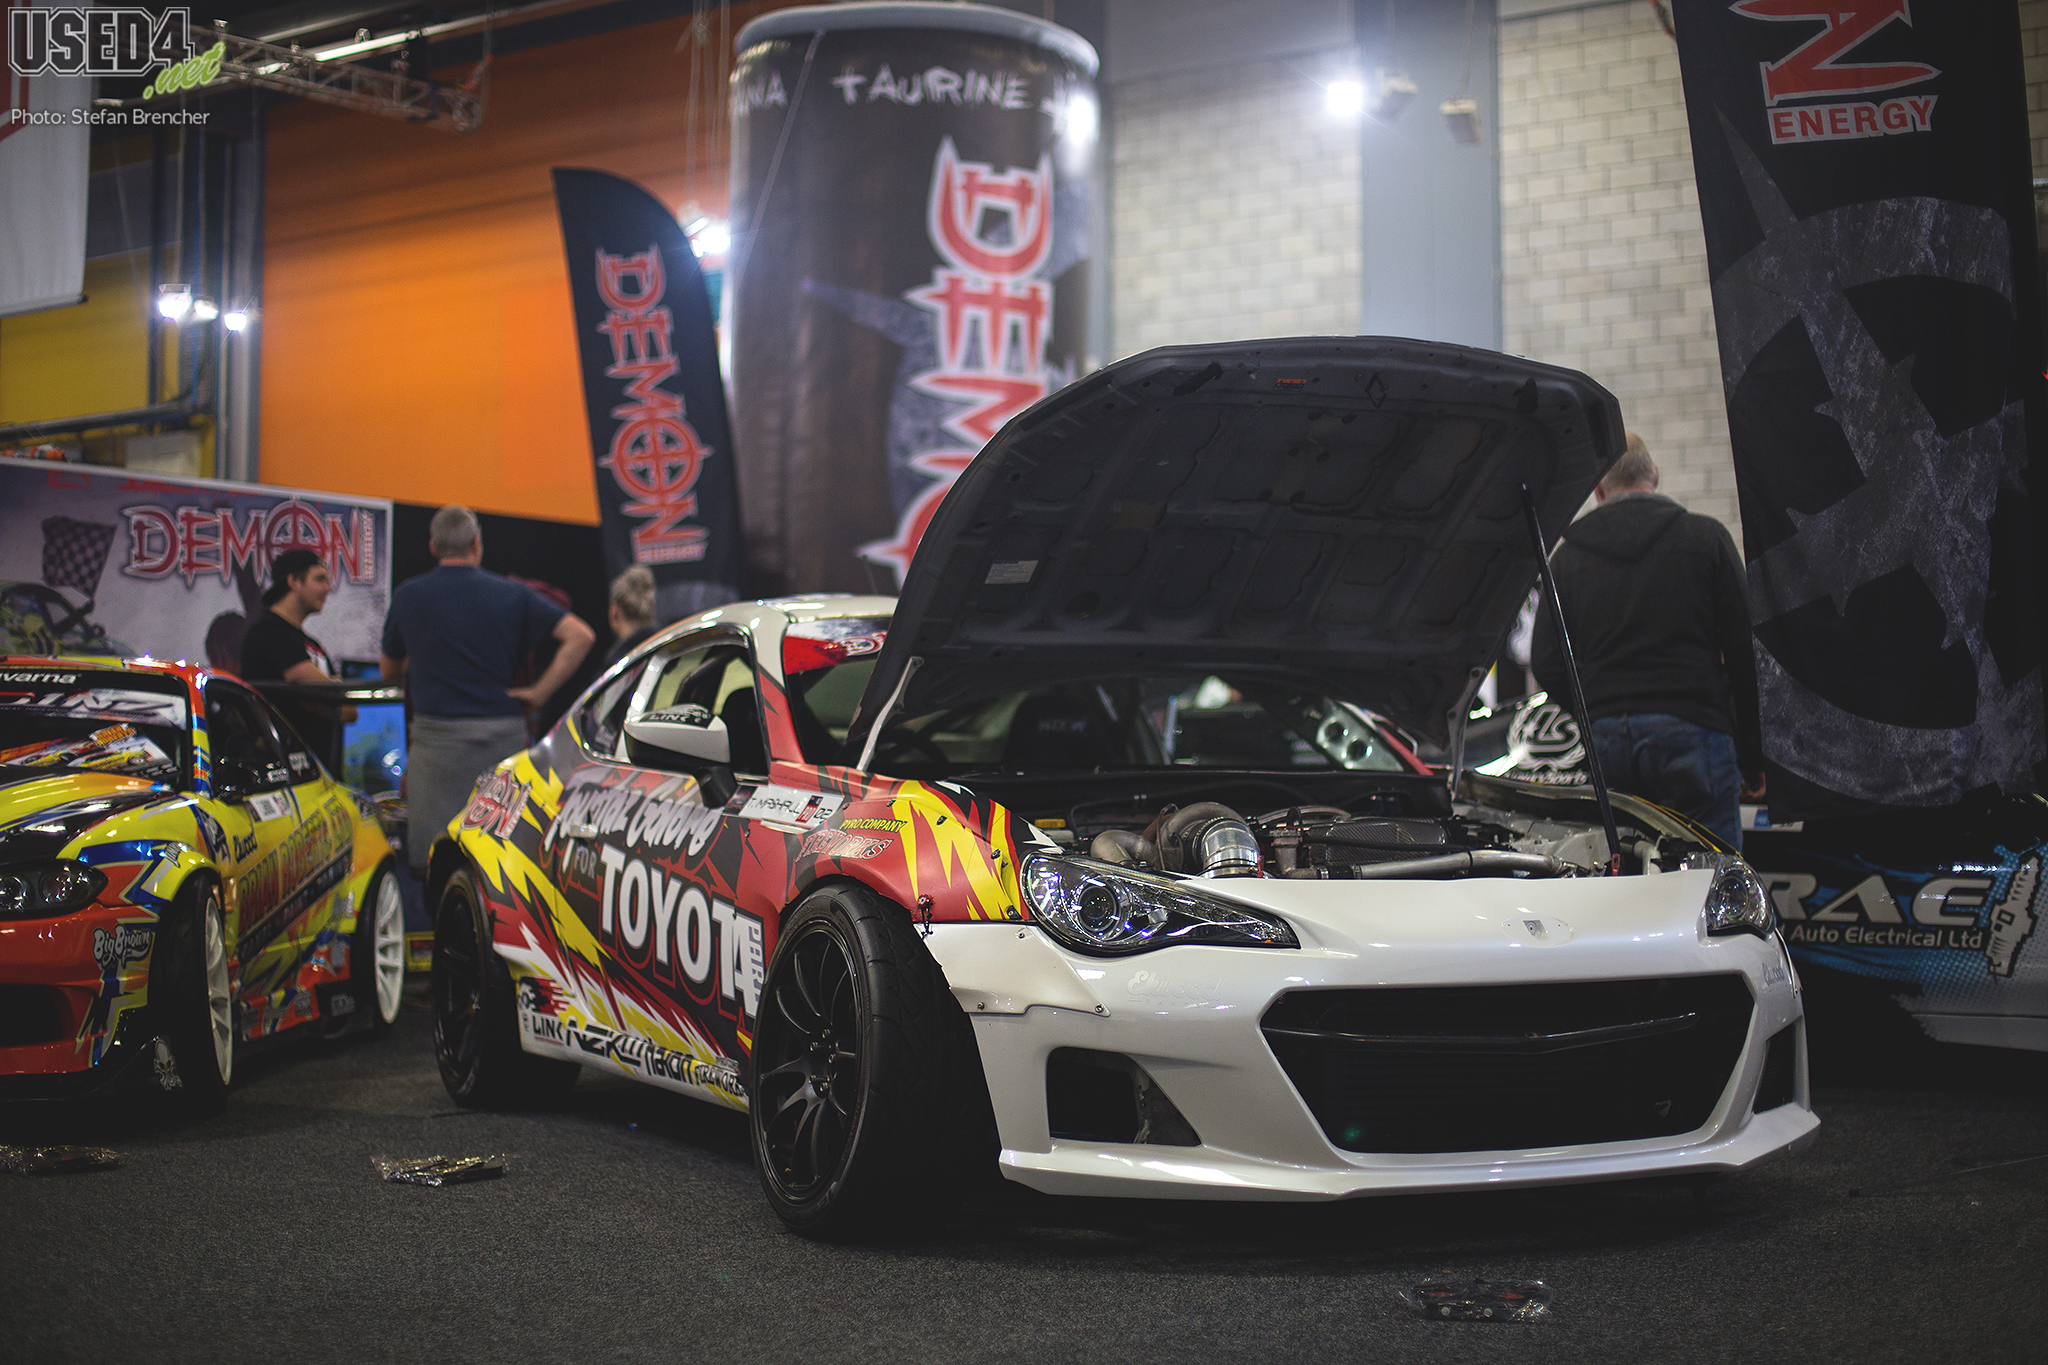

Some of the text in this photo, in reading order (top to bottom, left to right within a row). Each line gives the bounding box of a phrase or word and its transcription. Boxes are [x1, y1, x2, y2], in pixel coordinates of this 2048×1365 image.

[830, 62, 1033, 111] TAURINE
[1771, 98, 1935, 140] ENERGY
[596, 244, 714, 543] DEMON
[0, 671, 77, 685] varna
[839, 818, 908, 833] PYRO COMPANY
[795, 828, 894, 860] FIREWORKS
[574, 845, 599, 879] FOR
[600, 843, 763, 1020] TOYOTA
[1790, 925, 1840, 943] Auto
[1844, 925, 1942, 948] Electrical
[1947, 929, 1982, 949] Ltd
